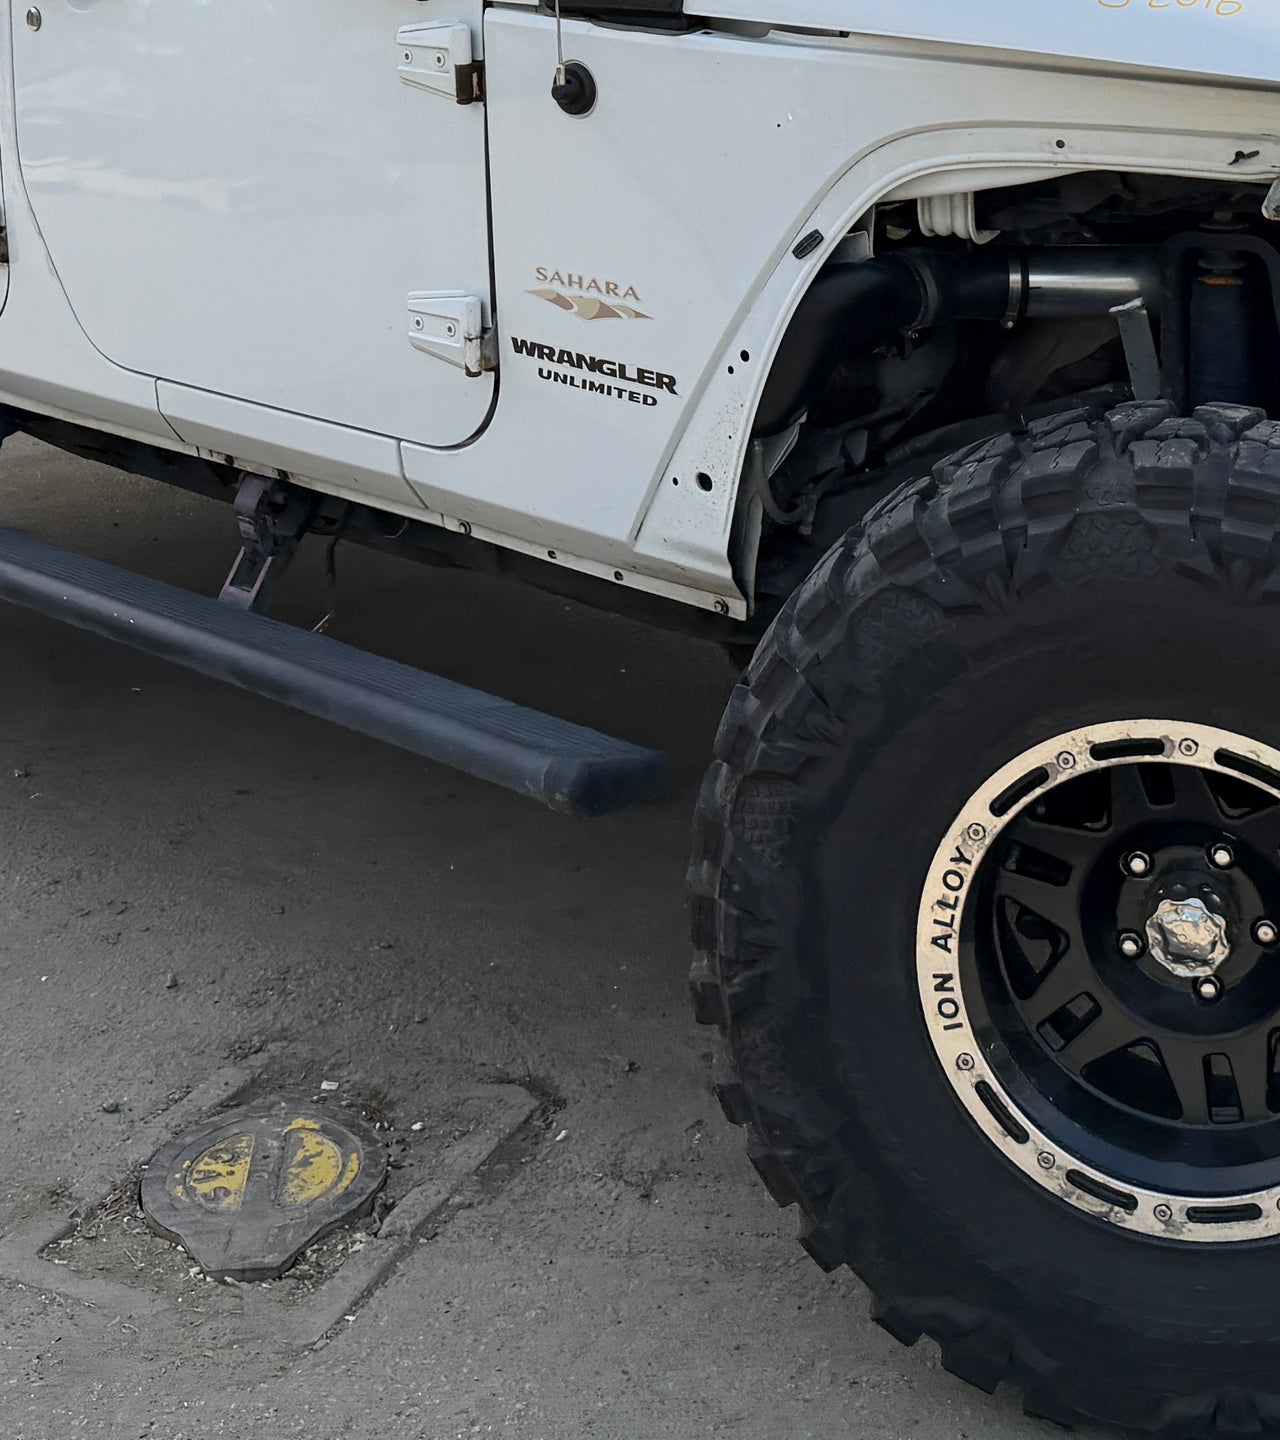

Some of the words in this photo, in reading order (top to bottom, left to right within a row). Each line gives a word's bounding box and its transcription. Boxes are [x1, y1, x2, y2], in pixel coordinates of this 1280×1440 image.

[535, 267, 641, 301] SAHARA
[511, 336, 679, 396] WRANGLER
[538, 367, 658, 407] UNLIMITED
[930, 845, 974, 953] ALLOY
[931, 972, 962, 1031] ION
